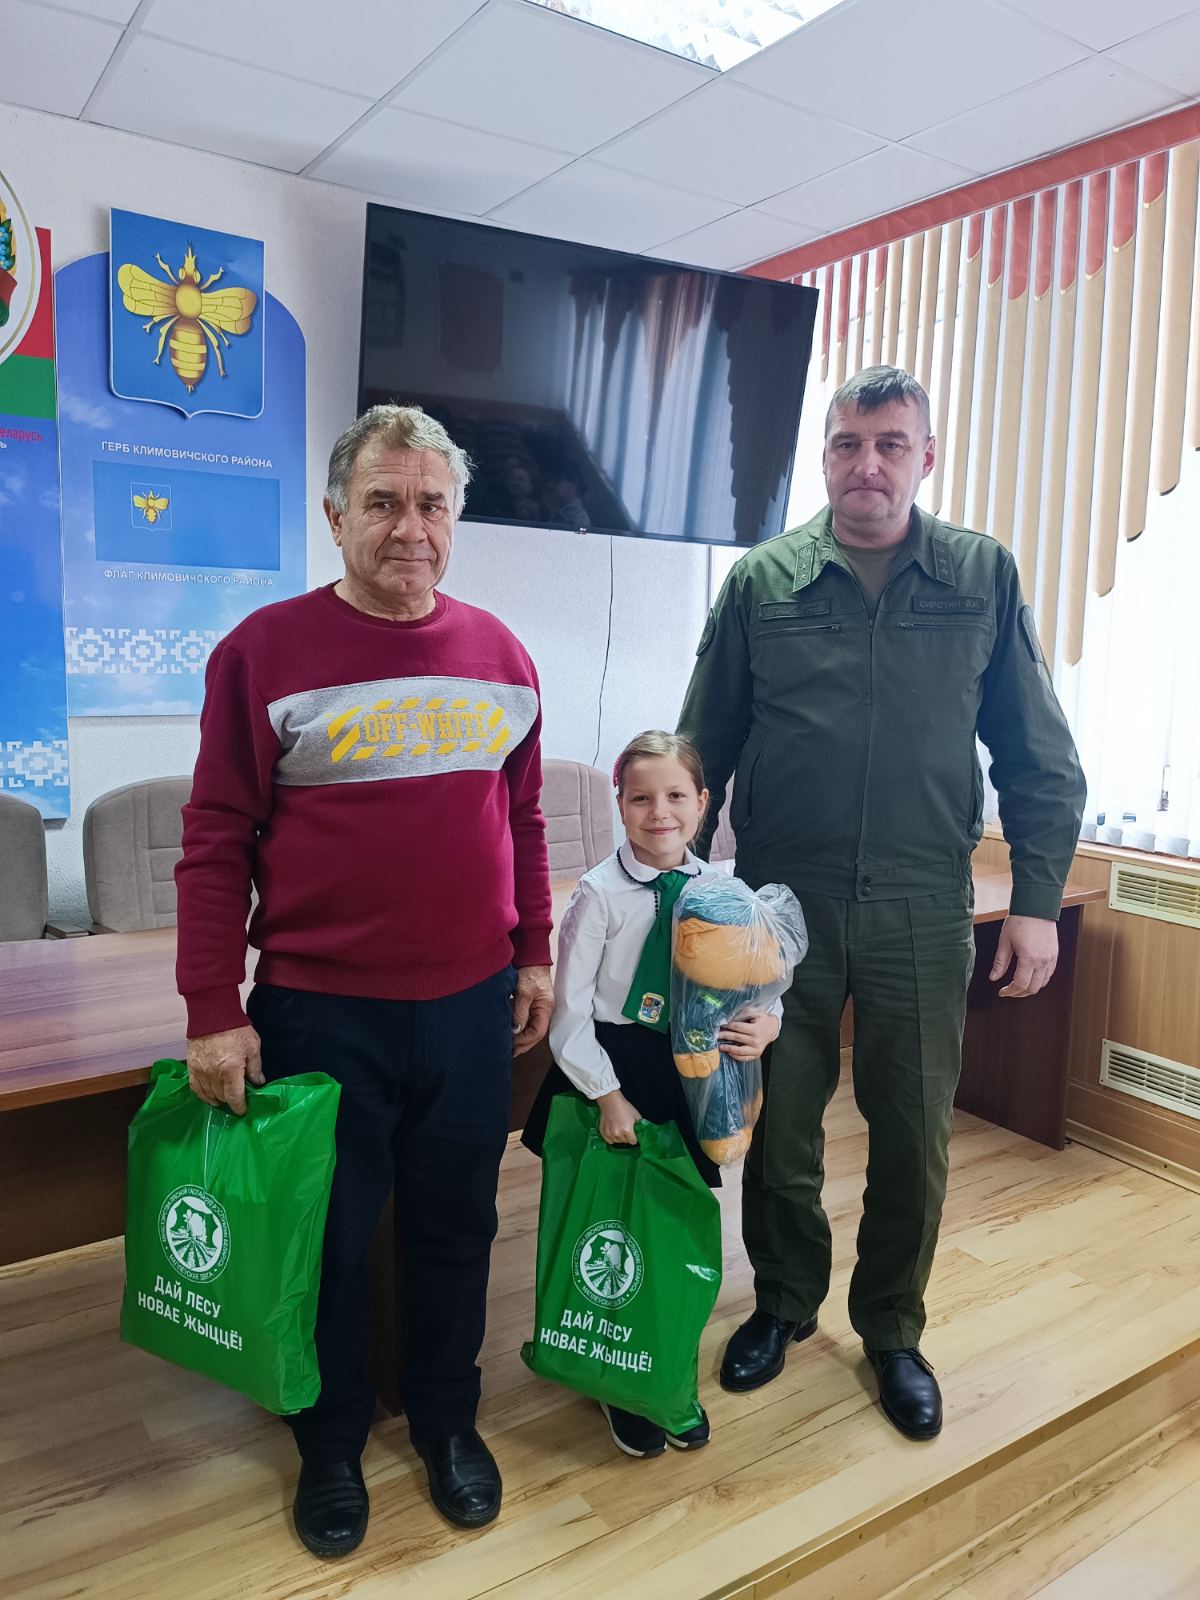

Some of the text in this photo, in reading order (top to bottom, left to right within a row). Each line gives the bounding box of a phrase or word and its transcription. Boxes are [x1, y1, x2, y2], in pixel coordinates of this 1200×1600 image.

[101, 440, 273, 469] ГЕРБ КЛИМОВИЧСКОГО РАЙОНА
[104, 569, 273, 586] ФЛАГ КЛИМОВИЧСКОГО РАЙОНА
[364, 712, 488, 743] OFF-WHITE
[154, 1275, 221, 1319] ДАЙ ЛЕСУ
[138, 1291, 243, 1351] НОВАЕ ЖЫЦЦЁ!
[560, 1309, 632, 1342] ДАЙ ЛЕСУ
[540, 1327, 652, 1373] НОВАЕ ЖЫЦЦЁ!
